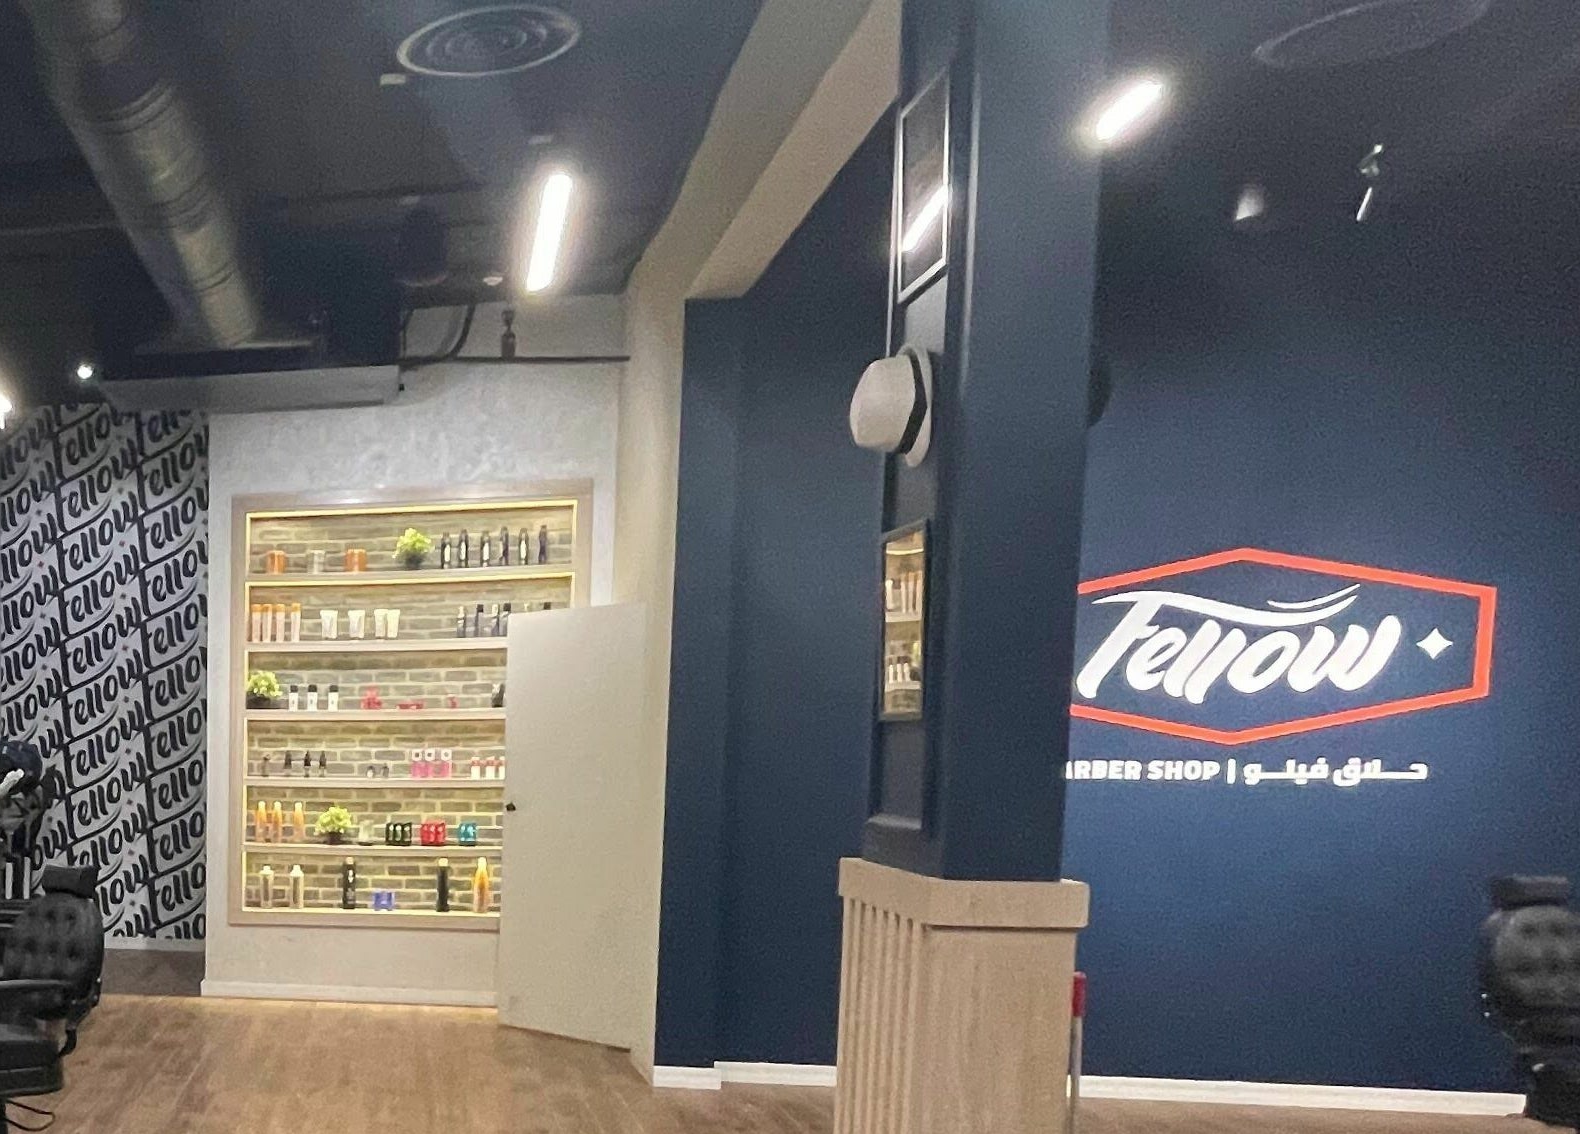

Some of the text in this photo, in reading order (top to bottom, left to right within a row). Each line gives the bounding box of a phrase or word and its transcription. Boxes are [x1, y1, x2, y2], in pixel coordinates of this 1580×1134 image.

[45, 491, 139, 586] Fellow
[46, 545, 140, 637] Fellow
[48, 597, 141, 688] Fellow
[1076, 583, 1402, 704] Fellow
[50, 650, 142, 739] Fellow
[53, 701, 145, 789] Fellow
[1147, 760, 1220, 780] SHOP
[1243, 757, 1329, 786] فيلو
[53, 752, 146, 840] Fellow
